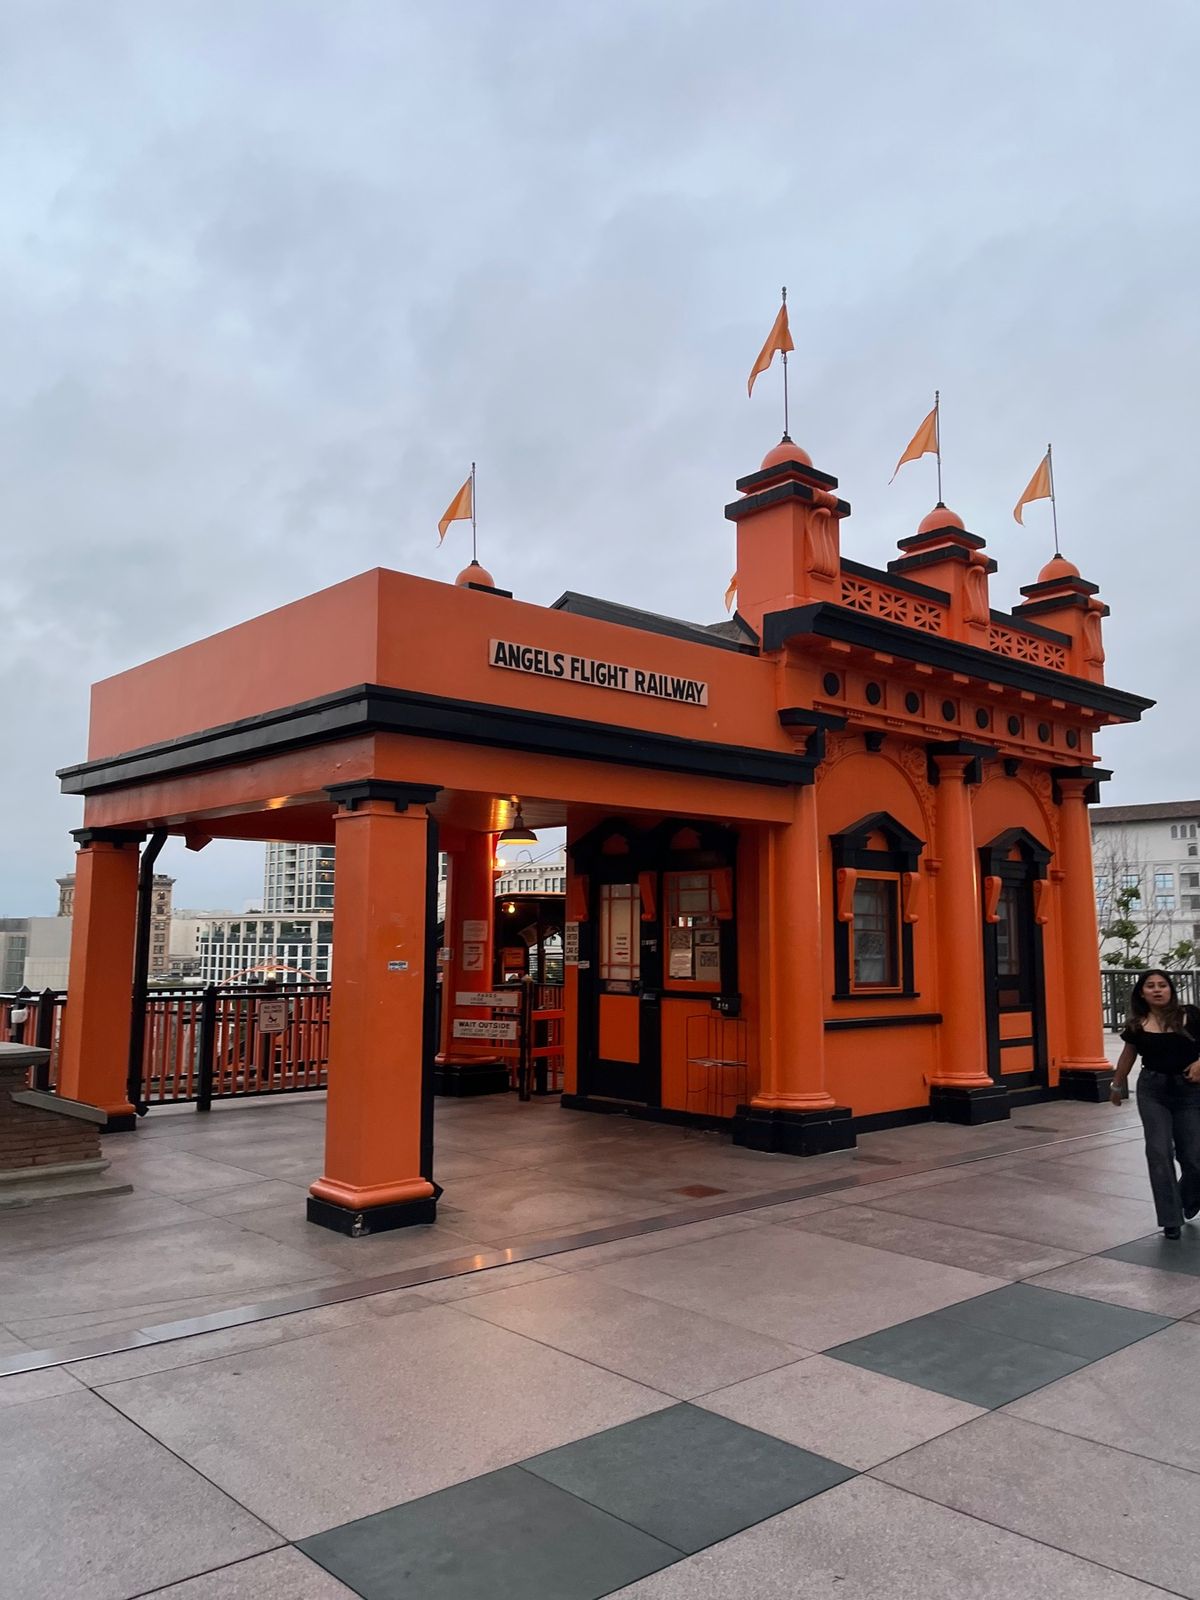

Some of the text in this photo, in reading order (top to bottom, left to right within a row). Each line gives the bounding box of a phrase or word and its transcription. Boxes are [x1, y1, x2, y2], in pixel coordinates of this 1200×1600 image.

[494, 641, 705, 703] ANGELS FLIGHT RAILWAY
[478, 1021, 511, 1029] OUTSIDE
